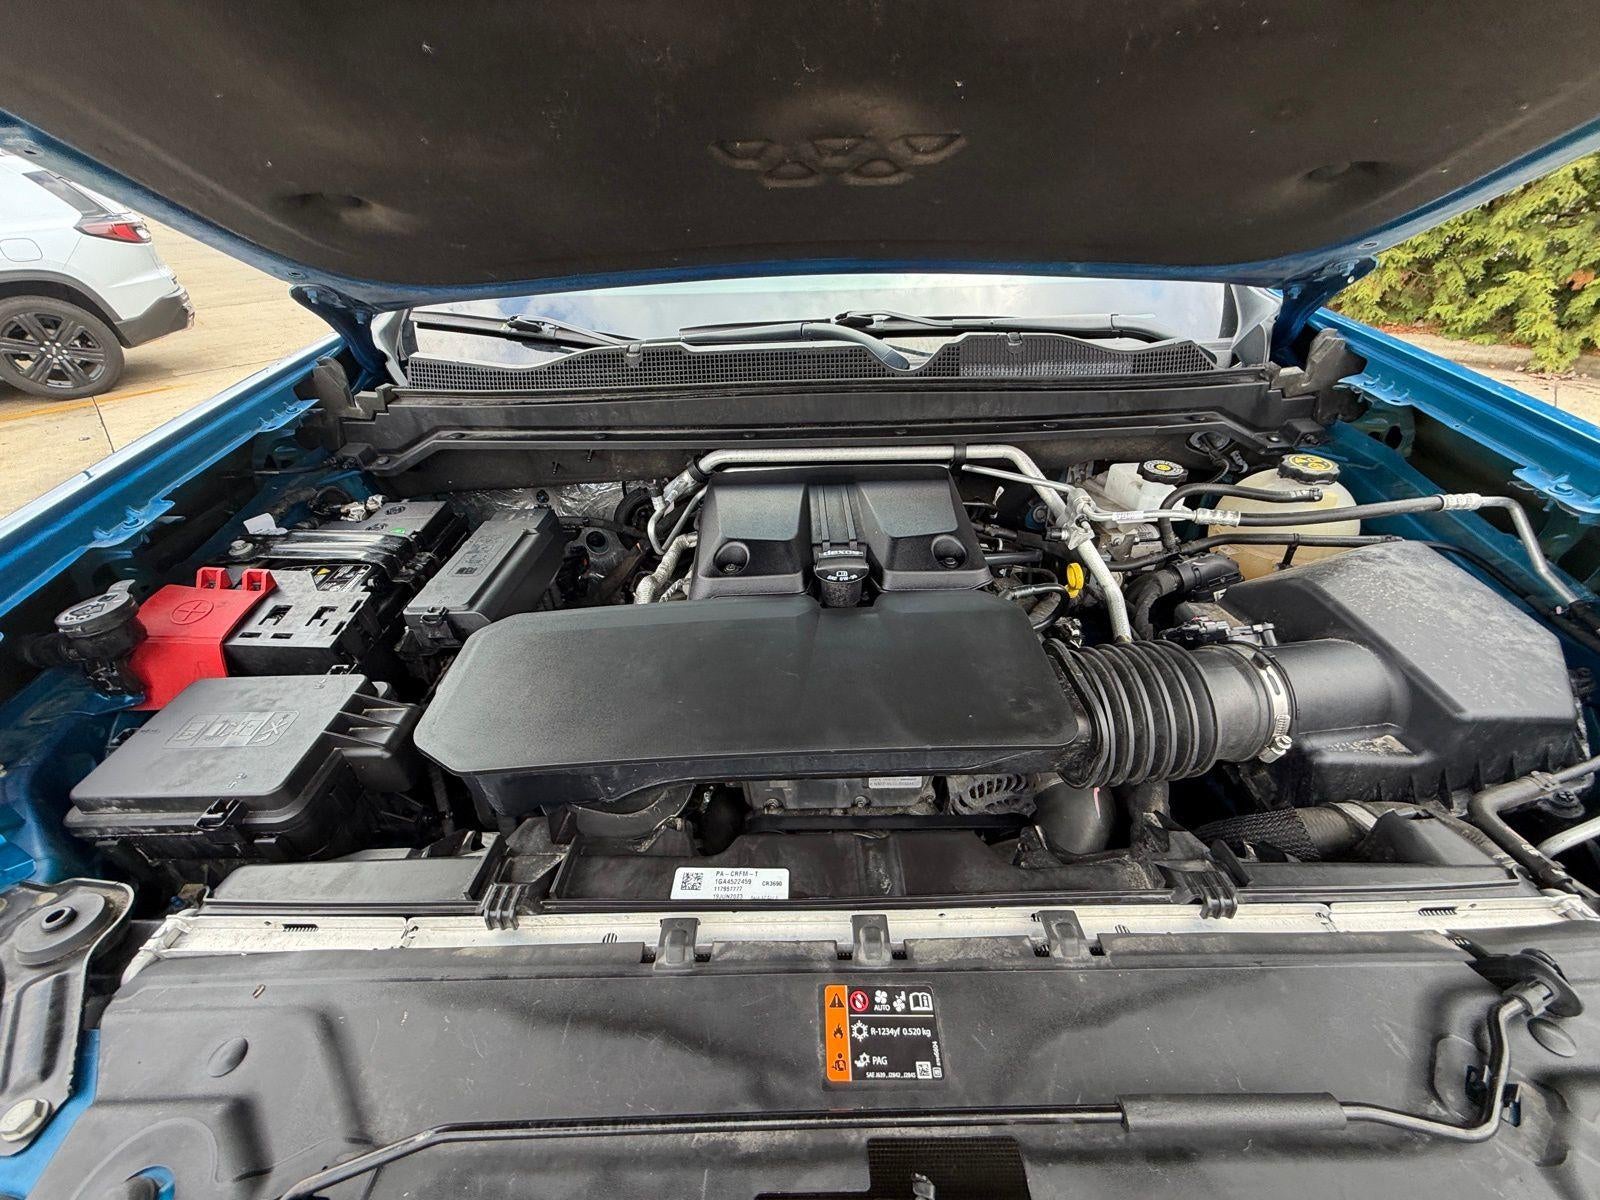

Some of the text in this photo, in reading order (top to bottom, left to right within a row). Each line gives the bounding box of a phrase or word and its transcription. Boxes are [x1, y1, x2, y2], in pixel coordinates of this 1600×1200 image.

[870, 1027, 931, 1038] R-1234yf 0.520 kg
[872, 1056, 888, 1065] PAG
